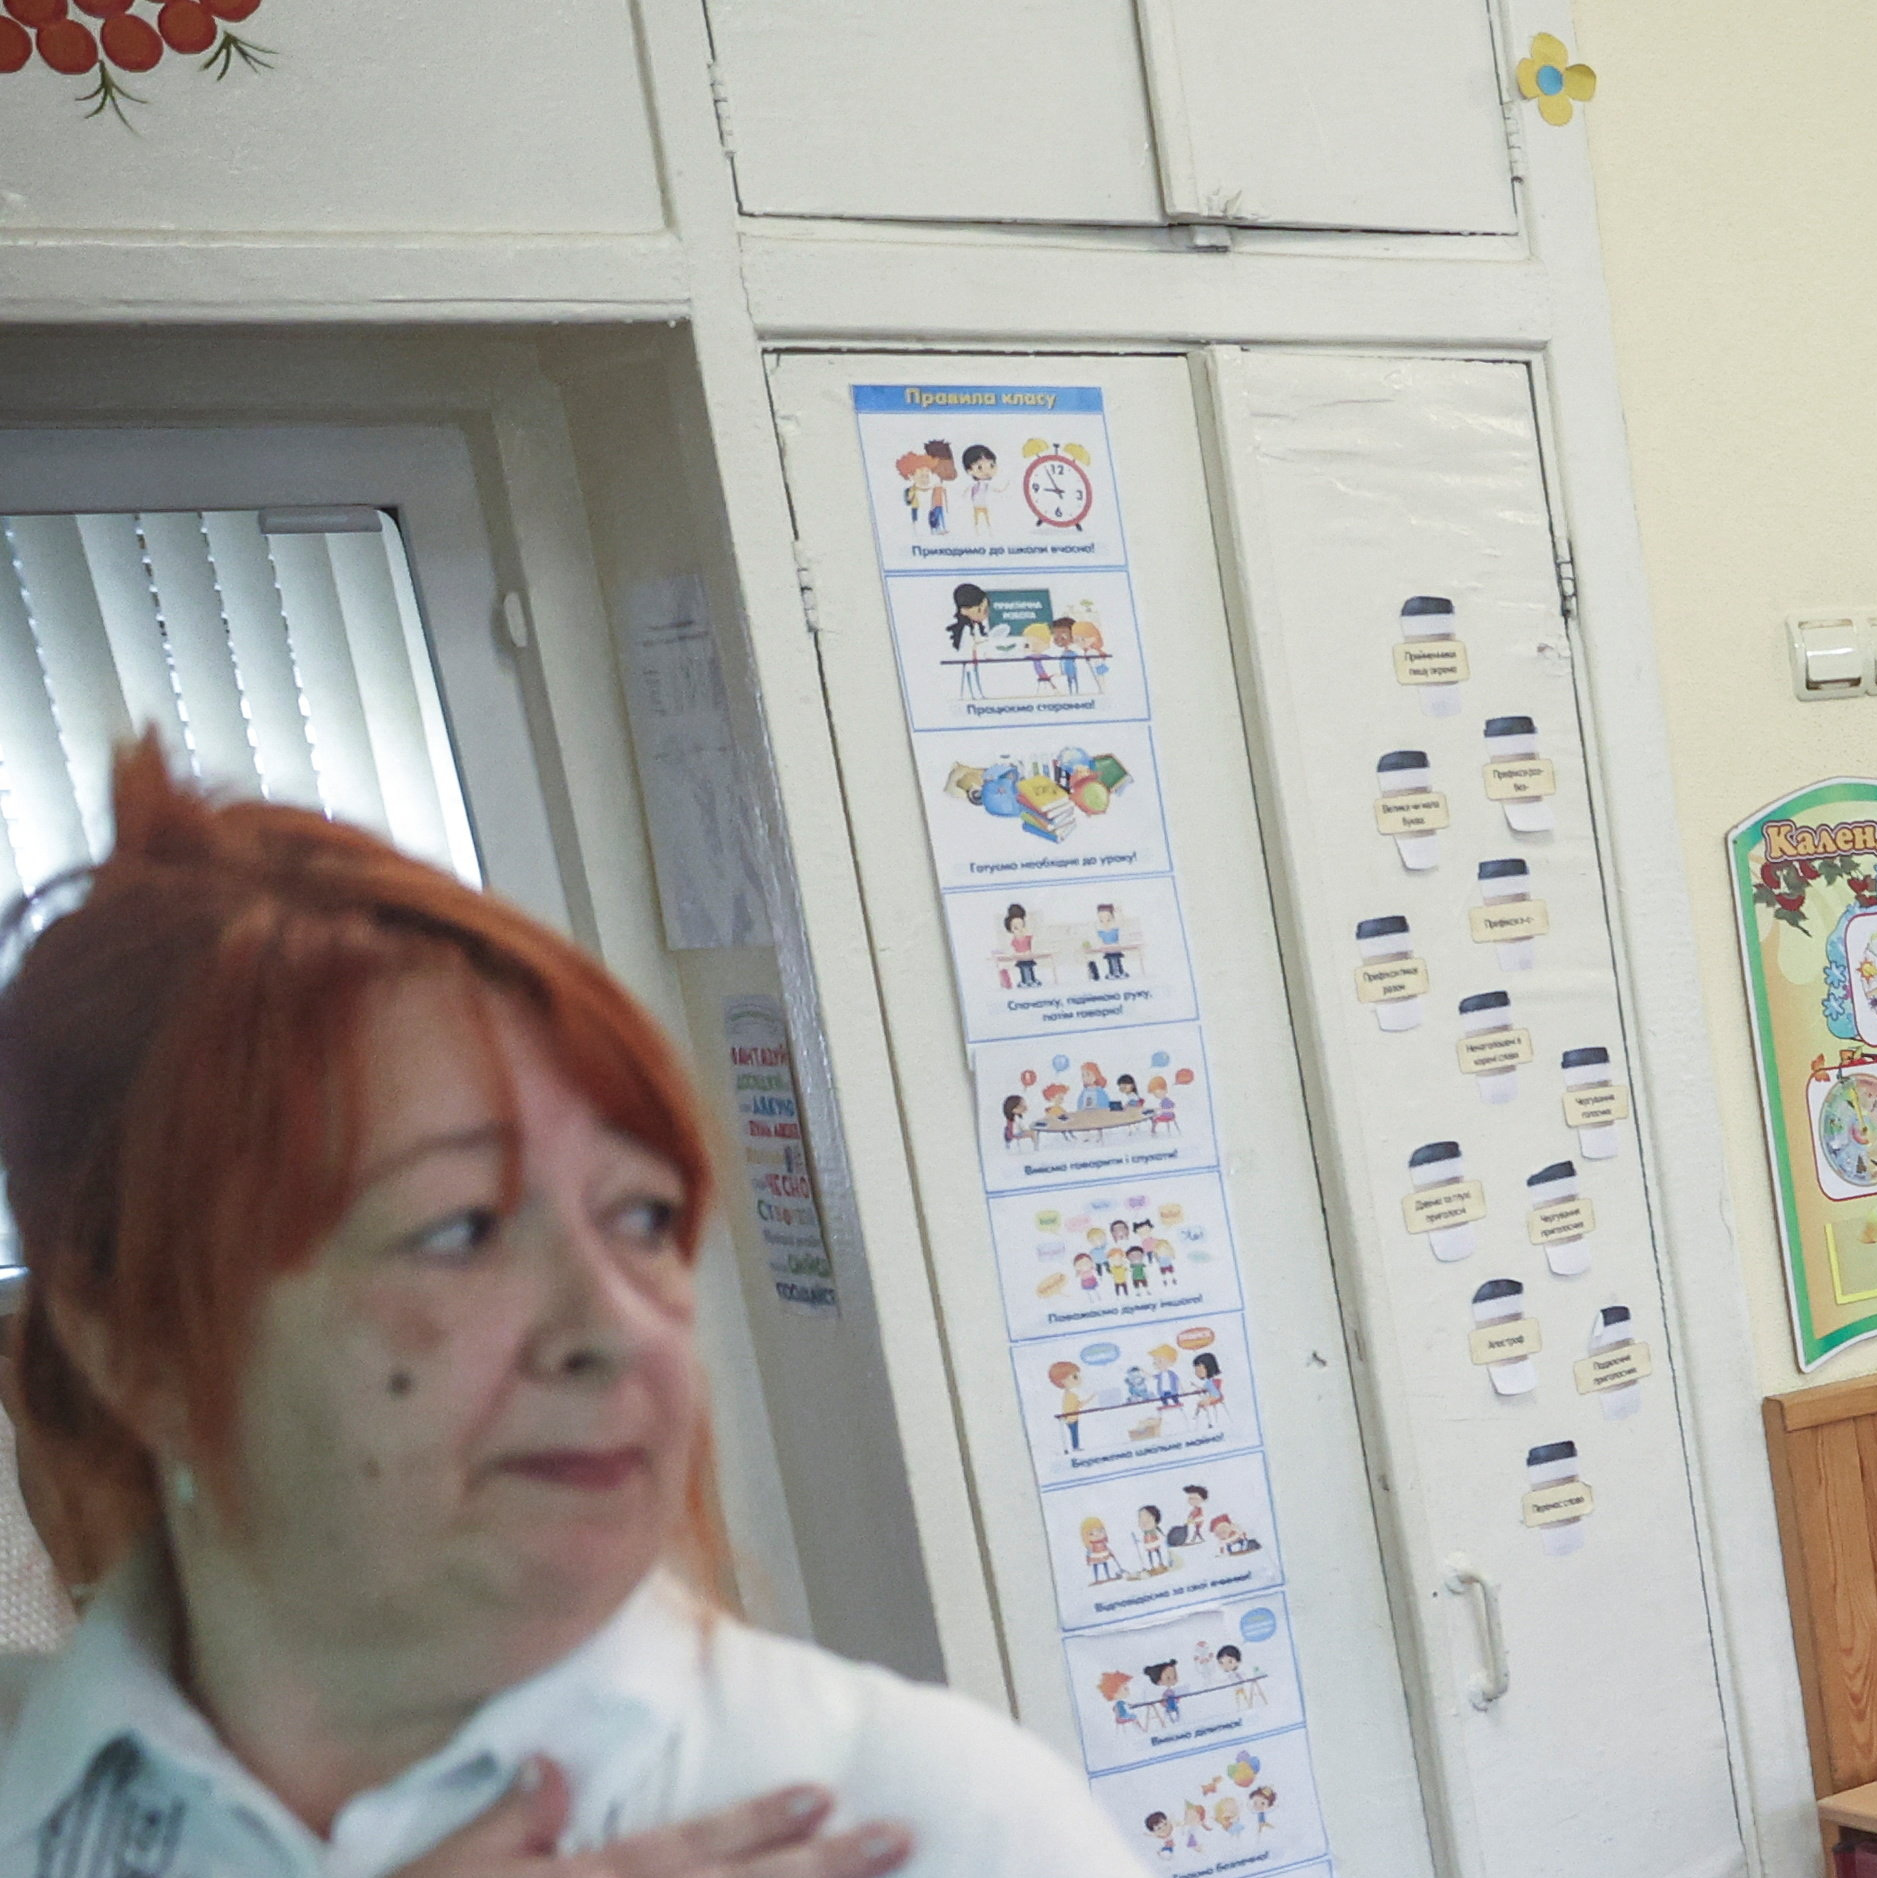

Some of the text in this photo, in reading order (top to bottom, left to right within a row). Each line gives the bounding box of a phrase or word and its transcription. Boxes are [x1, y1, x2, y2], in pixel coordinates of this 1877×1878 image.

[904, 388, 1057, 410] Правила класу
[1051, 465, 1064, 475] 12
[1032, 483, 1039, 493] 9
[1076, 490, 1083, 500] 3
[1055, 507, 1062, 517] 6
[912, 542, 1095, 558] Приходимо до школи вчасно!
[967, 700, 1095, 717] Працюємо старанно!
[970, 851, 1137, 874] Готуємо необхідне до уроку!
[1042, 1009, 1074, 1021] потім
[1048, 1306, 1119, 1325] Поважаємо
[1216, 1851, 1269, 1874] безпечно!
